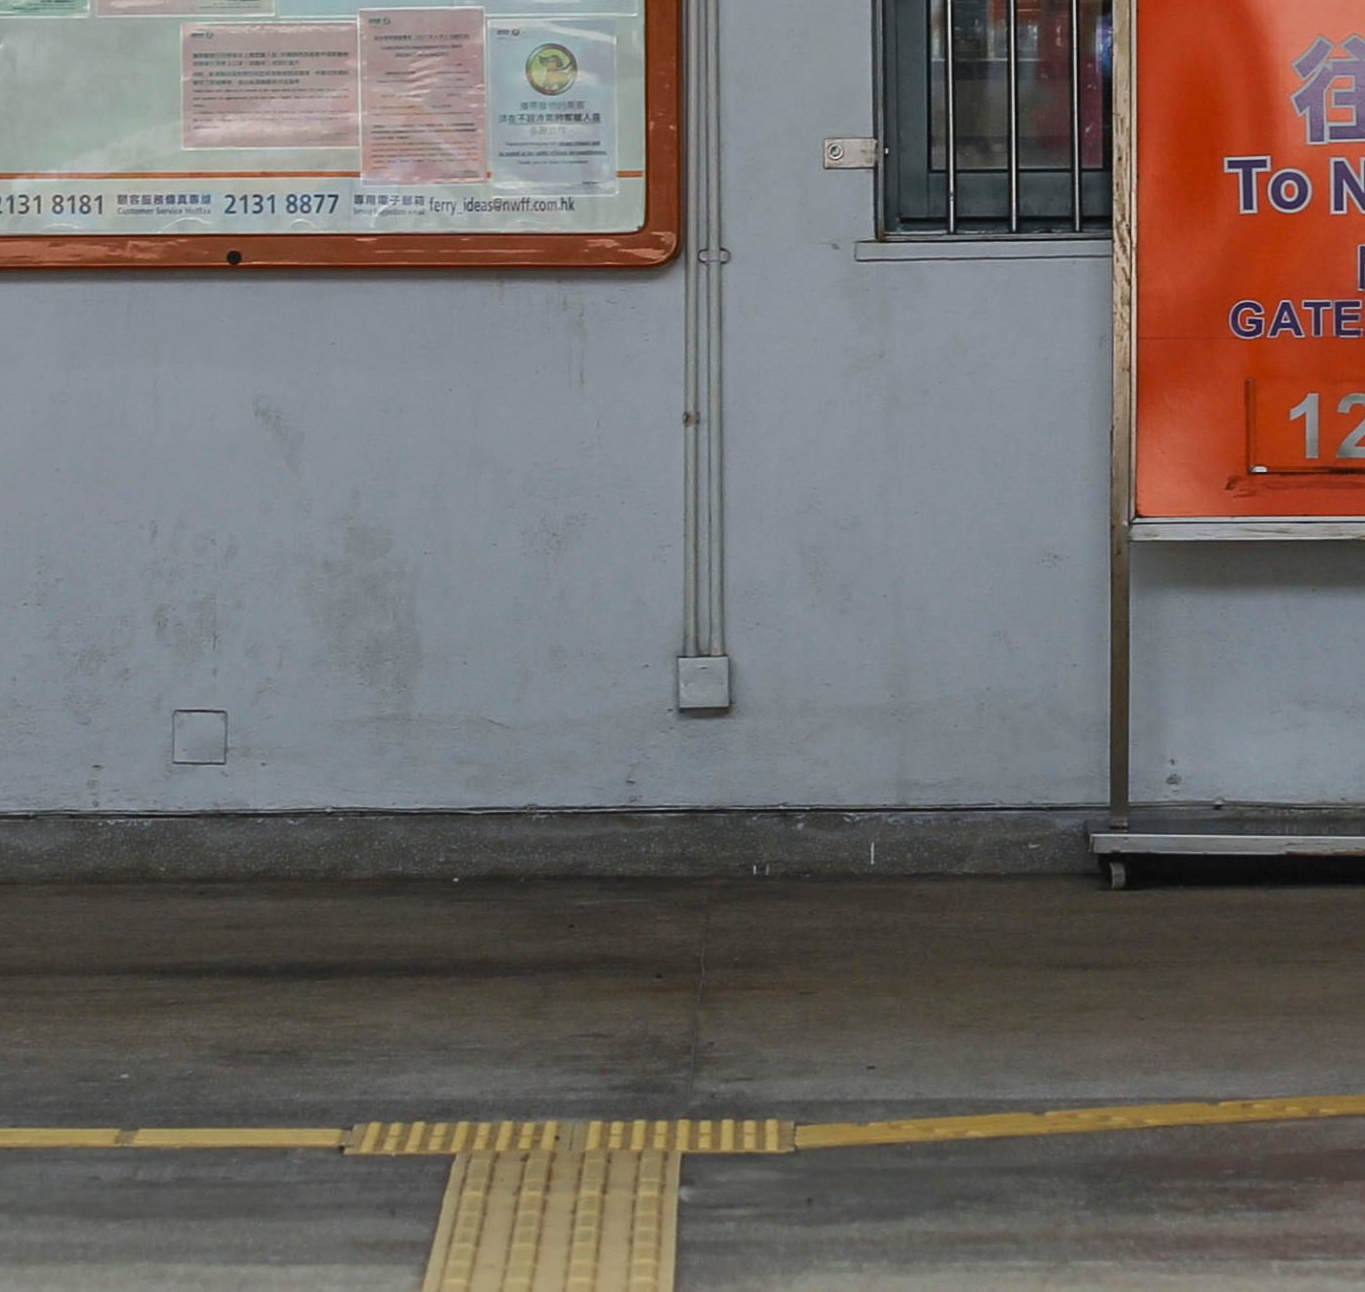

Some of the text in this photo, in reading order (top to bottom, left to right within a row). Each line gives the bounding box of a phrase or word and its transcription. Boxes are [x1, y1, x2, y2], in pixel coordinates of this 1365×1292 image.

[1224, 155, 1311, 216] To
[51, 194, 104, 215] 8181
[224, 194, 276, 214] 2131
[286, 194, 339, 214] 8877
[429, 197, 576, 216] ferry_ideas@nwff.com.hk
[1229, 299, 1363, 339] GATE
